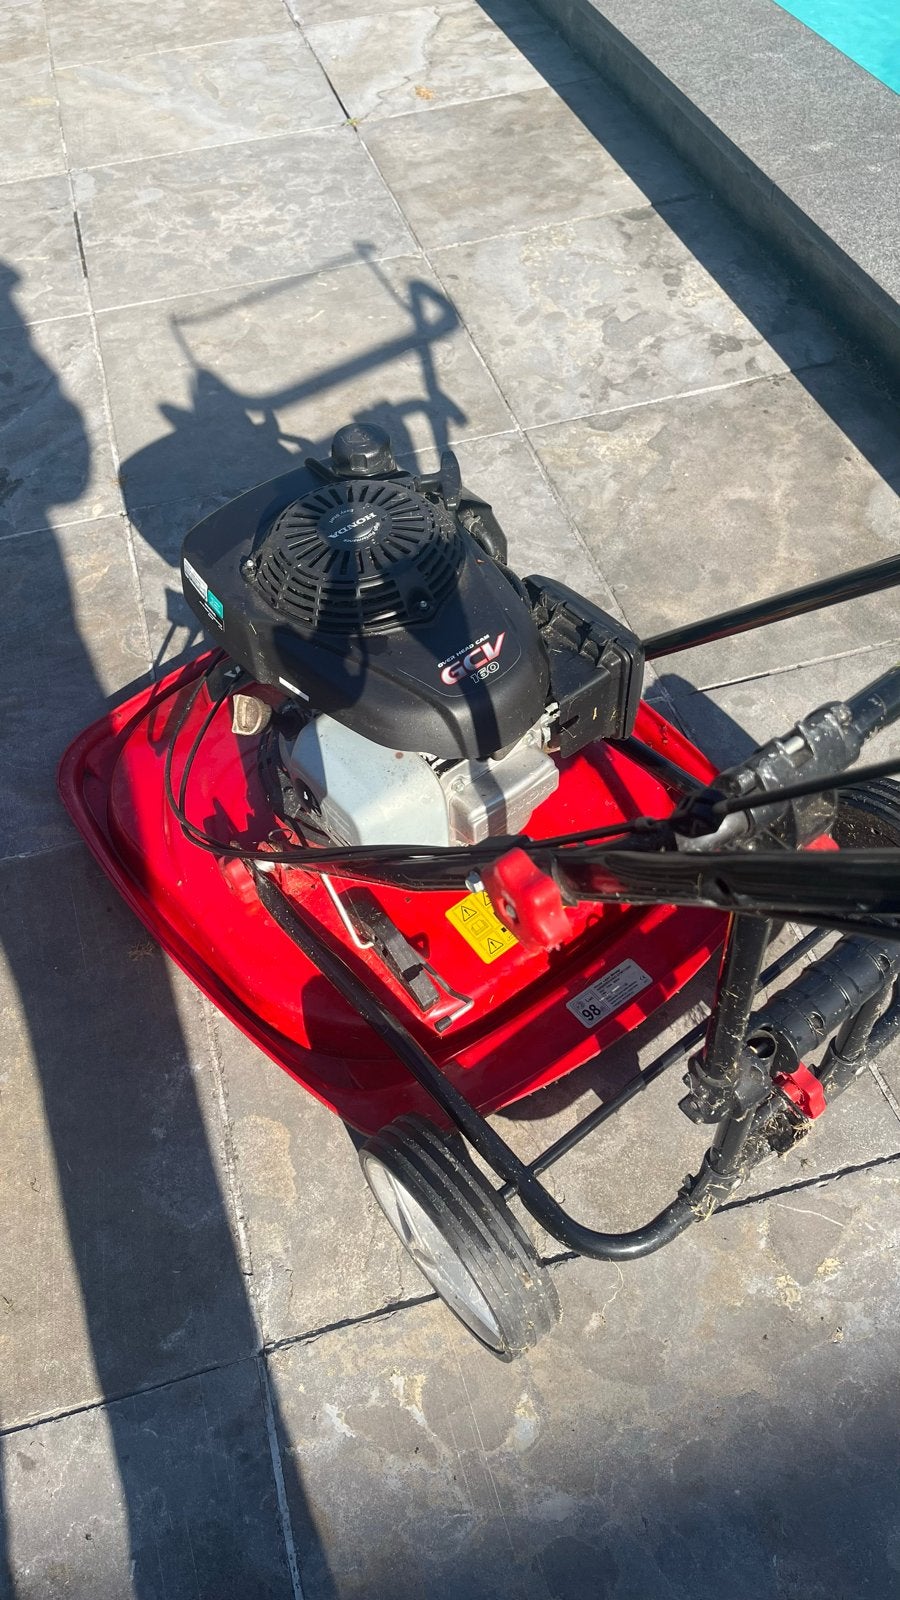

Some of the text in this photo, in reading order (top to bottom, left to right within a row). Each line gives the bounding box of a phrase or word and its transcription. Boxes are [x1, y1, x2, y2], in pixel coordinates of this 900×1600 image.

[327, 512, 378, 539] HONDA
[437, 633, 491, 669] OVER HEAD CAM
[441, 631, 506, 686] GCV
[469, 661, 500, 684] 160
[582, 1004, 601, 1020] 98
